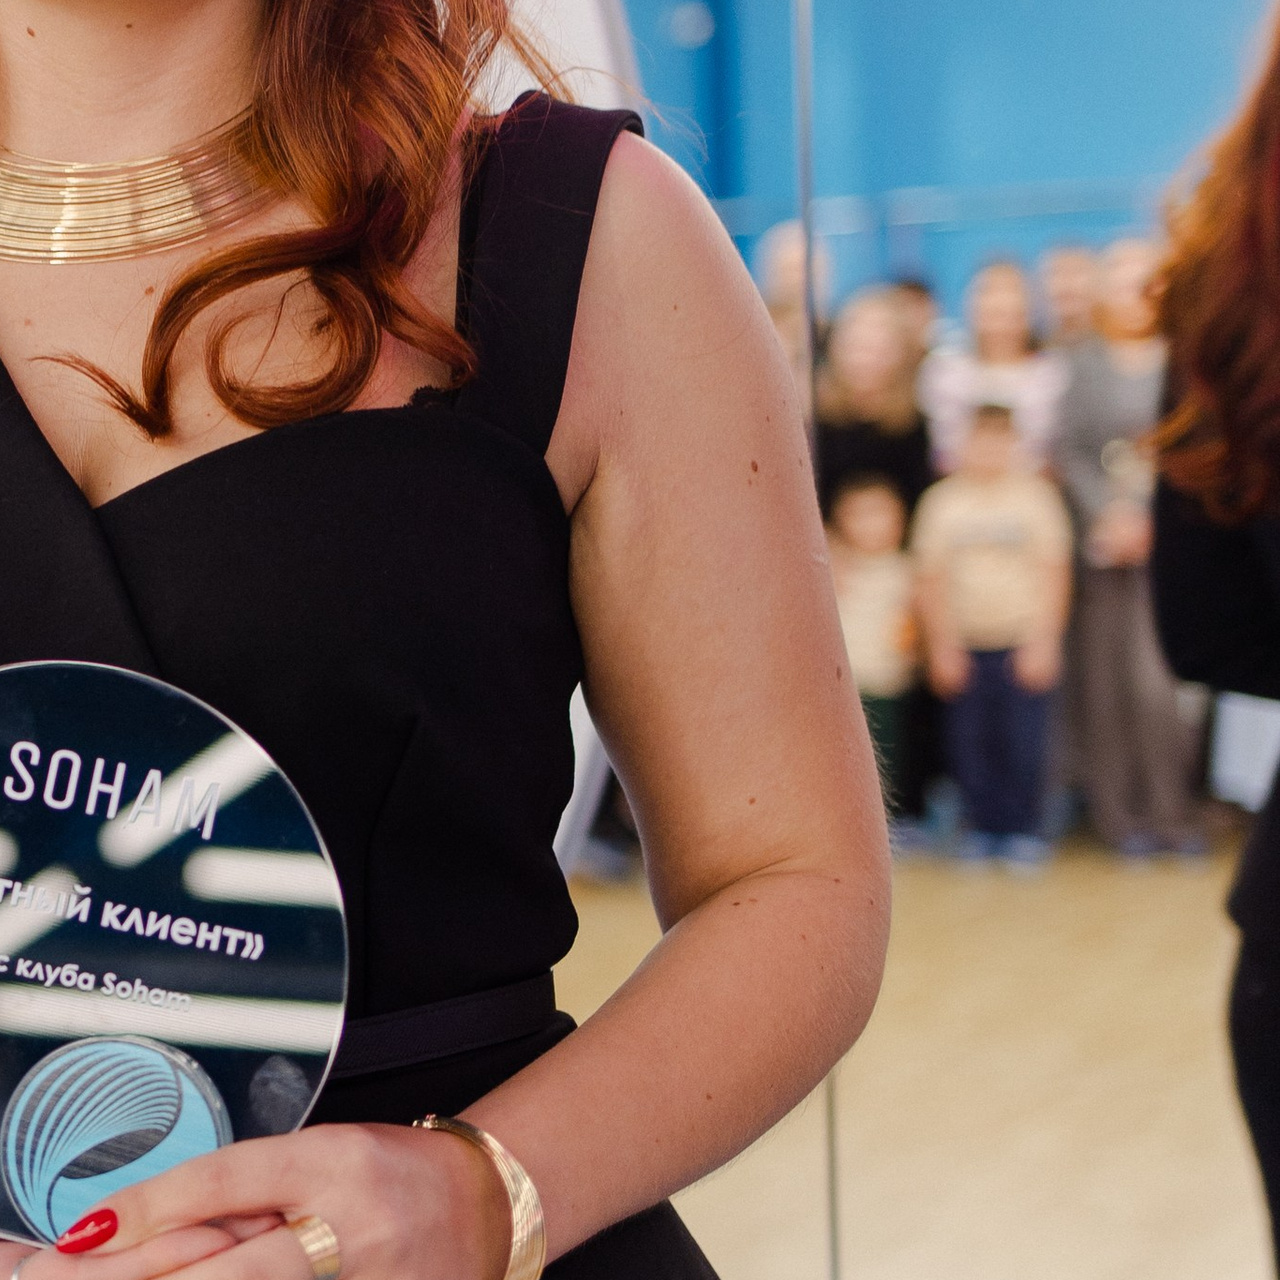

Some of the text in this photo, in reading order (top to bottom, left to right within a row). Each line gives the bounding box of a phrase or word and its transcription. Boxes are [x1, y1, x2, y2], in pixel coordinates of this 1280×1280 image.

[4, 740, 220, 840] SOHAM
[100, 900, 265, 961] клиент»
[16, 957, 96, 992] клуба
[100, 971, 192, 1013] Soham
